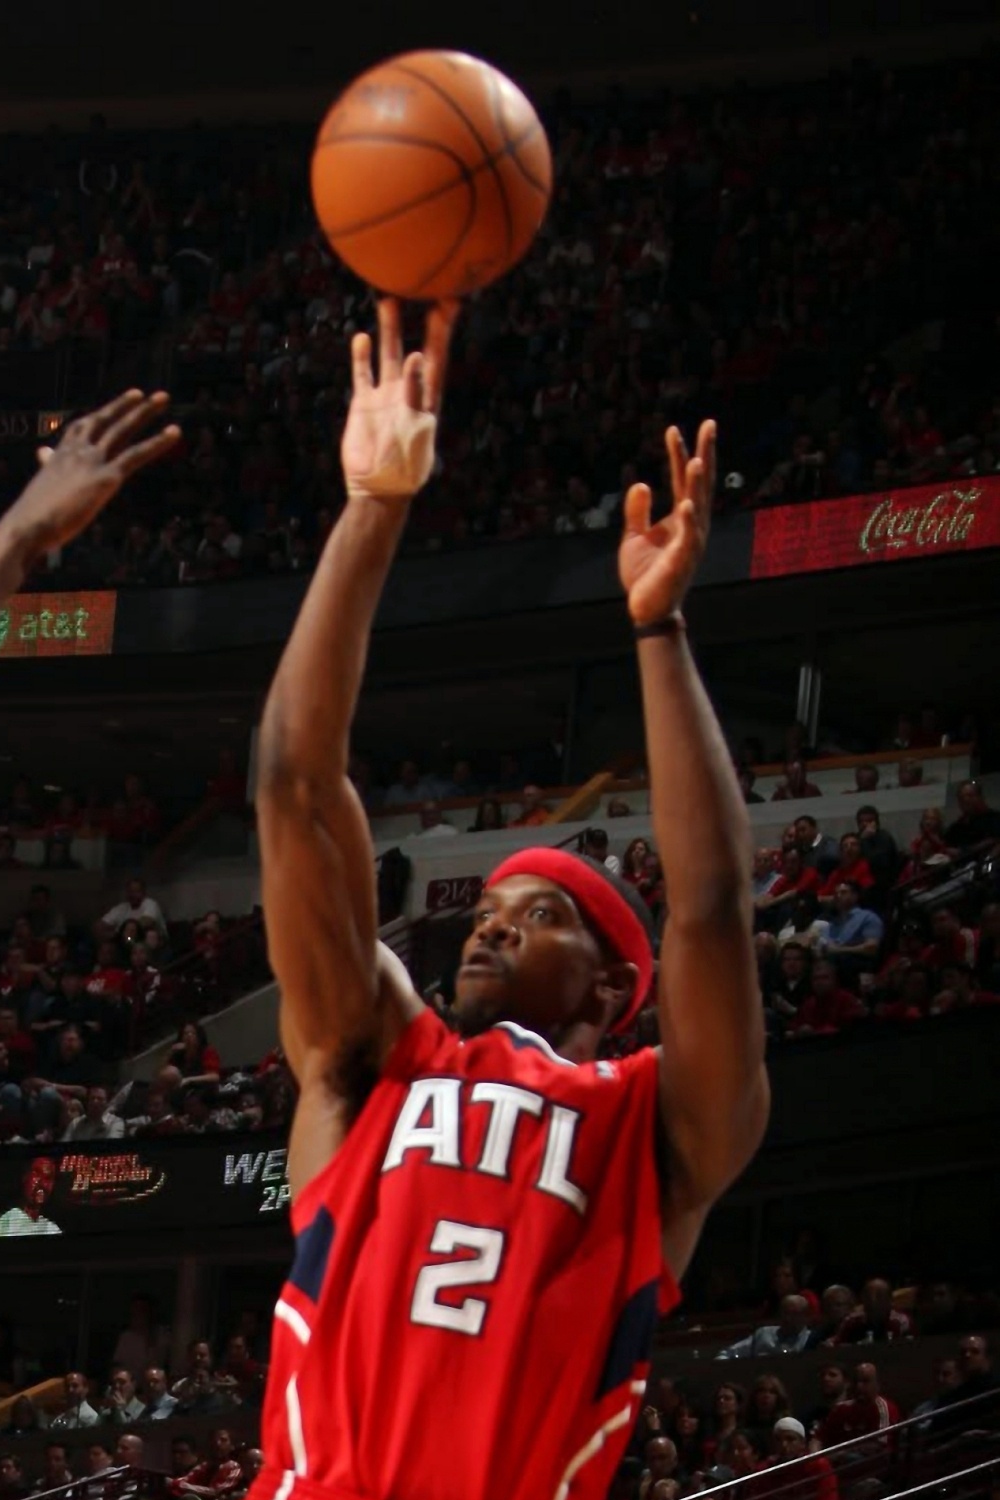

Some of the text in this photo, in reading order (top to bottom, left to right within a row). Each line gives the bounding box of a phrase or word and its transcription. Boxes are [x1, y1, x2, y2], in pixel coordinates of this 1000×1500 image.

[19, 607, 89, 639] at&t
[224, 1148, 290, 1185] WE
[381, 1077, 588, 1215] ATL
[409, 1218, 505, 1337] 2
